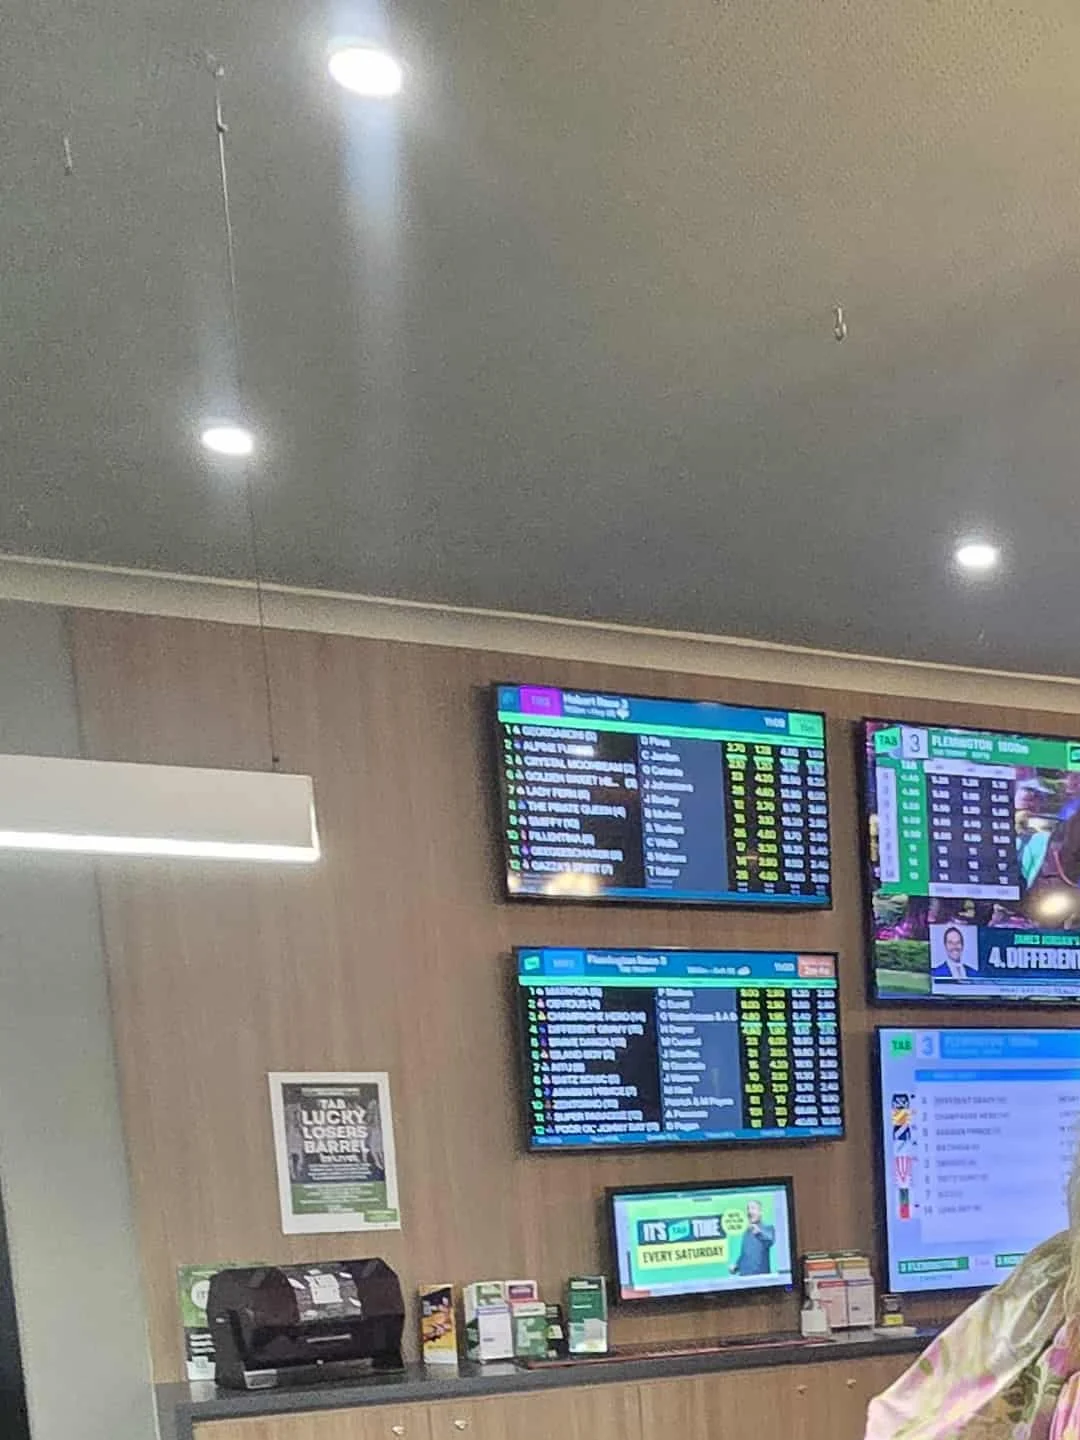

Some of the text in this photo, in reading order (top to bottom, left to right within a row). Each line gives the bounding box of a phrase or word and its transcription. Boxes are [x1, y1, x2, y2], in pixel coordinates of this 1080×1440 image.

[879, 734, 897, 746] TAB
[910, 734, 920, 752] 3
[932, 735, 993, 751] FLEMINGTON
[988, 946, 1005, 968] 4.
[892, 1040, 912, 1051] TAB
[923, 1037, 933, 1056] 3
[318, 1098, 346, 1110] TAB
[301, 1109, 367, 1125] LUCKY
[302, 1125, 368, 1139] LOSERS
[303, 1140, 370, 1155] BARREL
[643, 1222, 667, 1241] IT'S
[692, 1219, 720, 1238] TIME
[642, 1246, 723, 1263] EVERY SATURDAY
